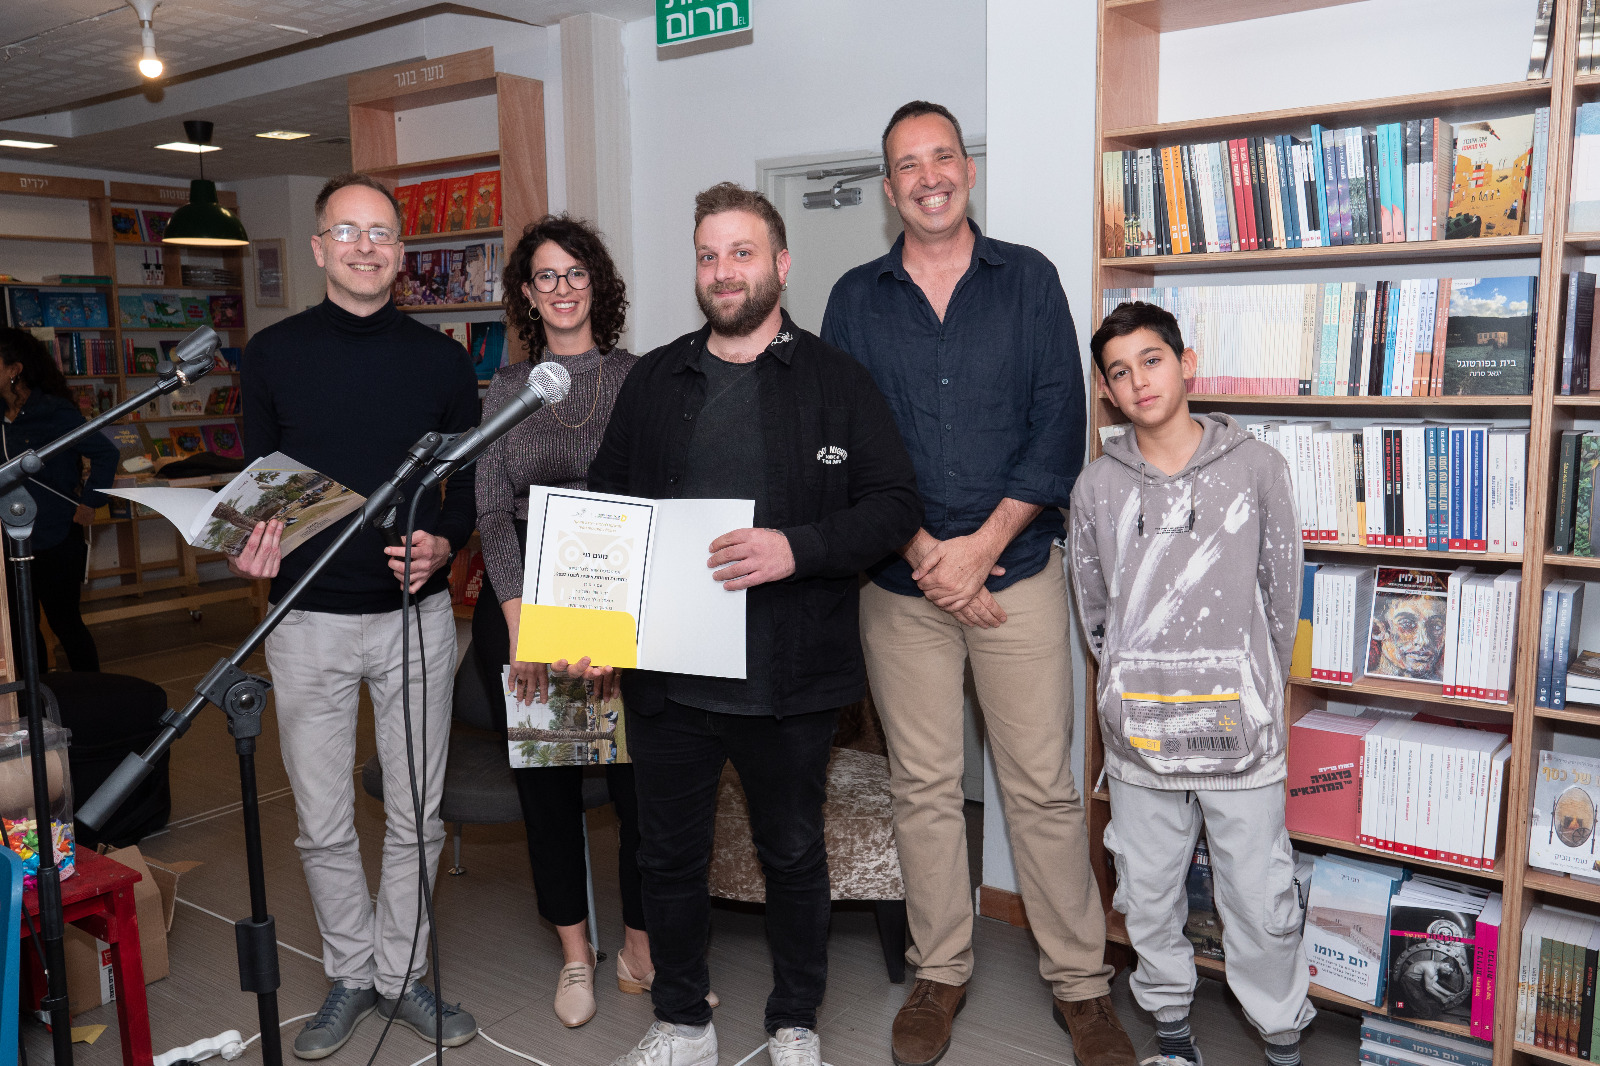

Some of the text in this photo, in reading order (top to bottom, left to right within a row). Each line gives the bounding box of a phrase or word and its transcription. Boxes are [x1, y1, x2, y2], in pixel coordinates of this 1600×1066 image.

[666, 2, 738, 39] חרום
[394, 64, 444, 88] נוער בוגר
[20, 177, 49, 188] ילדים
[1457, 359, 1516, 368] בית בפורטוגל
[1428, 456, 1437, 471] מסע
[1439, 456, 1448, 471] מסע
[1428, 472, 1437, 482] עם
[1439, 472, 1448, 482] עם
[1398, 573, 1433, 584] חנוך לוין
[1310, 769, 1352, 784] פדגוגיה
[1542, 766, 1592, 786] של כסף
[1289, 781, 1344, 797] המדוכאים
[1554, 853, 1588, 865] נעמי נוביק
[1313, 943, 1369, 968] יום ביומו
[1411, 1043, 1460, 1061] יום ביומו
